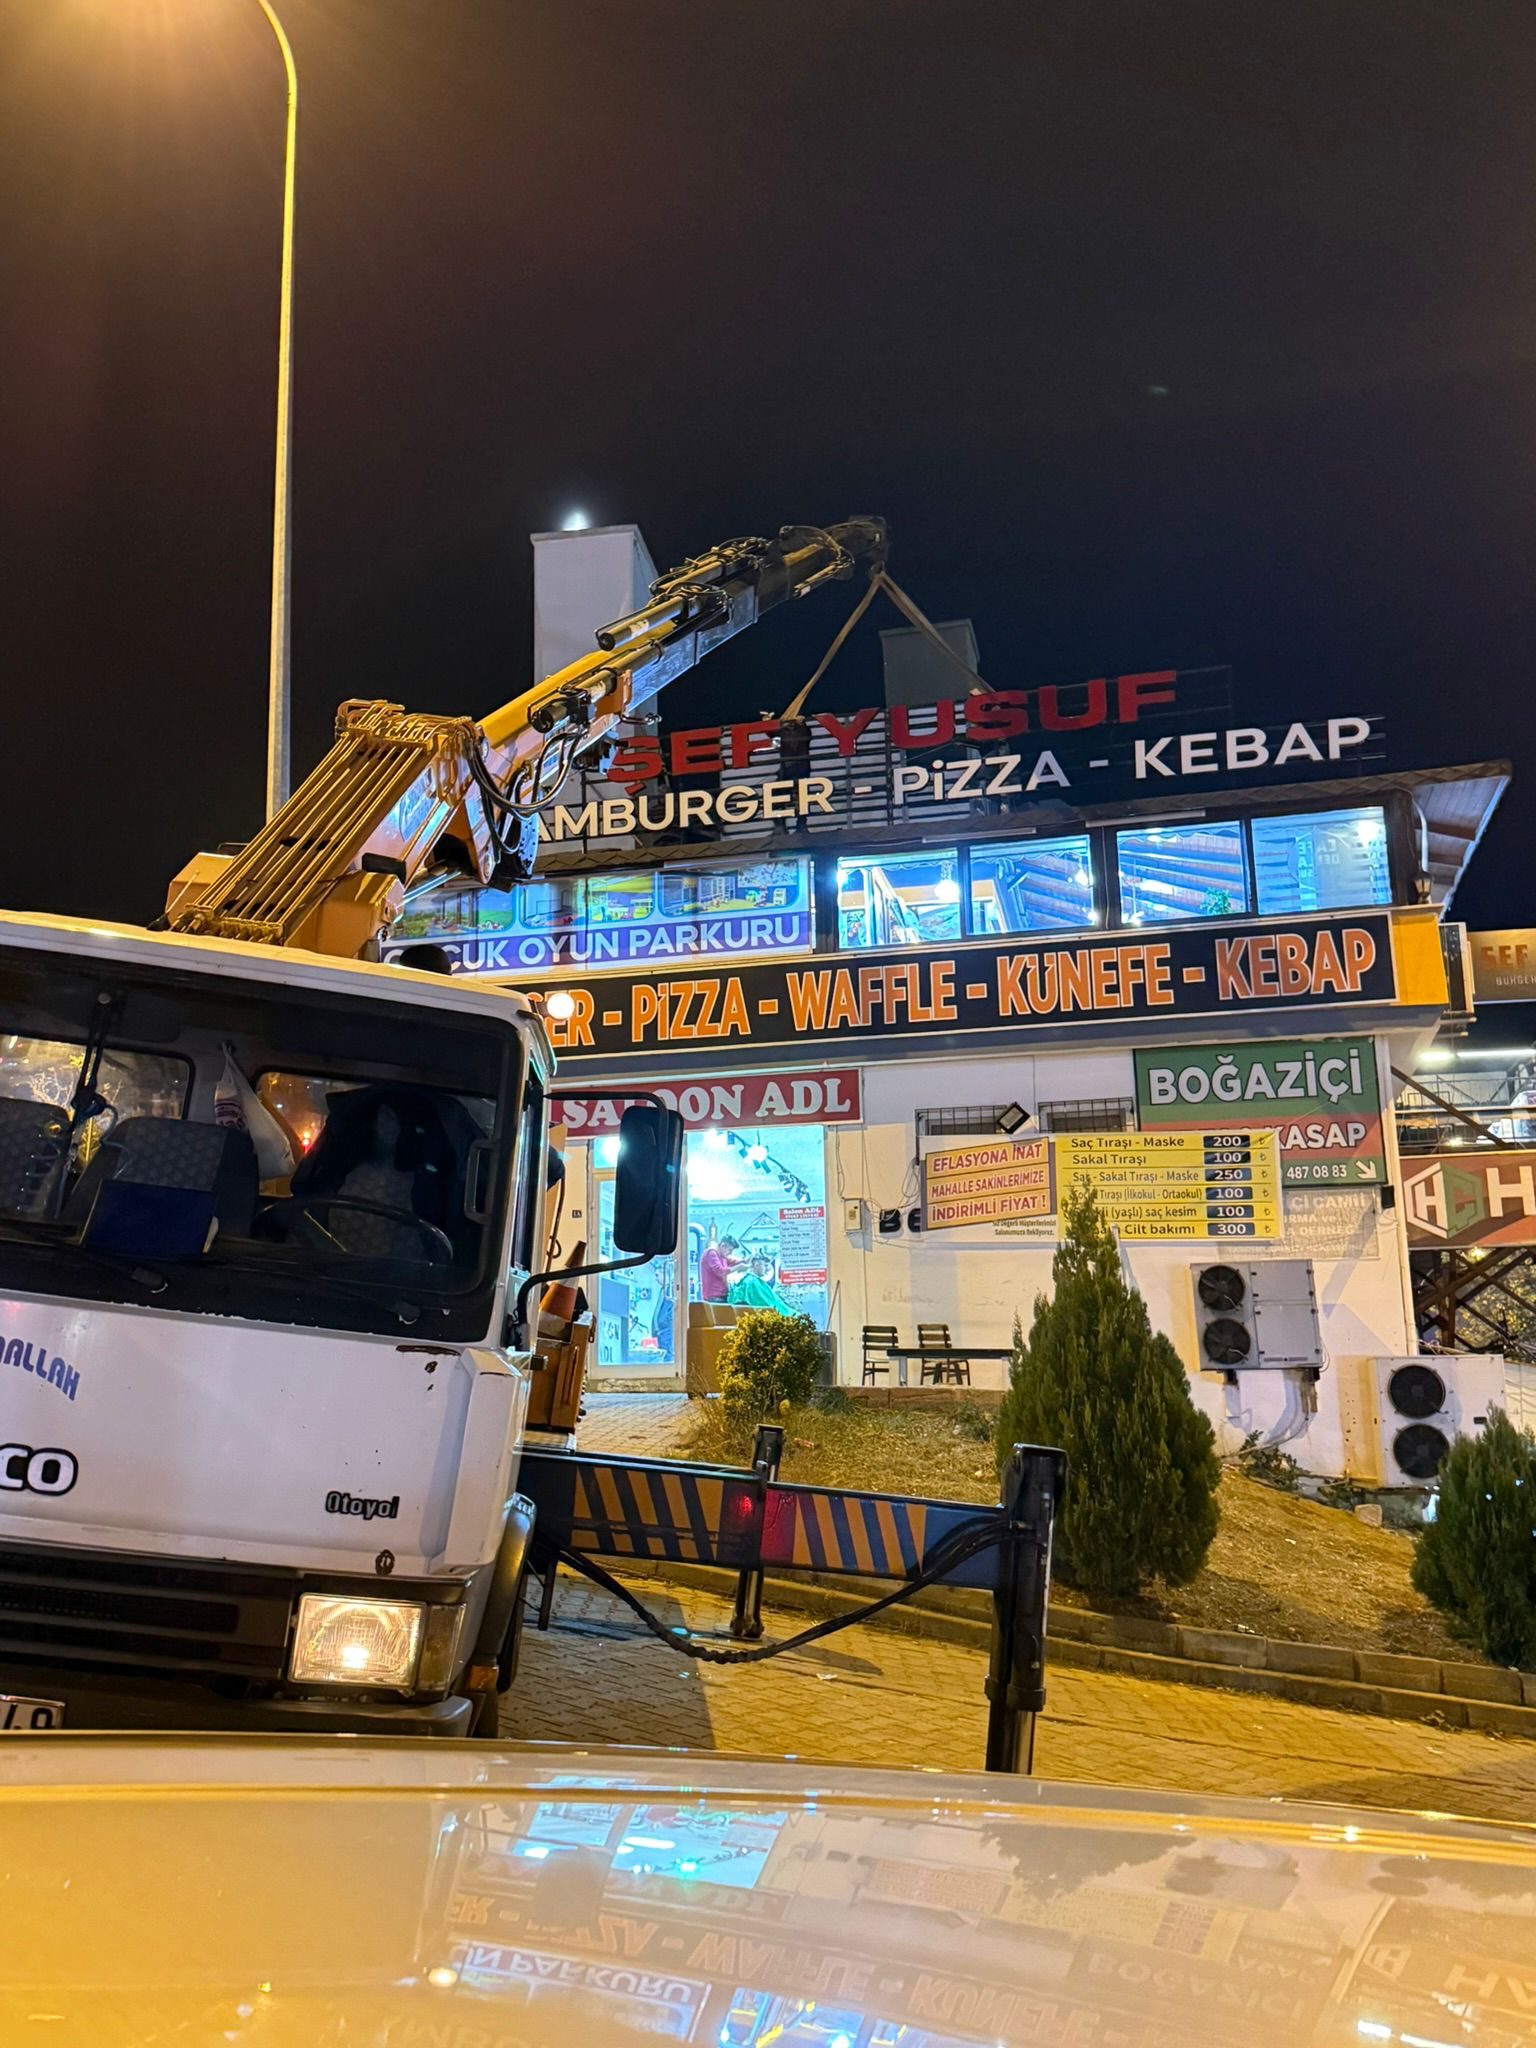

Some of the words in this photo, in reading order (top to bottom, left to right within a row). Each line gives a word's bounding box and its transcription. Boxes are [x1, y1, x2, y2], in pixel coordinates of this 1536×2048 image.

[606, 720, 781, 795] ŞEF
[815, 670, 1177, 756] YUSUF
[538, 776, 834, 842] MBURGER
[1134, 717, 1371, 779] KEBAP
[383, 939, 510, 973] CUK
[518, 928, 619, 965] OYUN
[630, 916, 800, 957] PARKURU
[786, 960, 958, 1030] WAFFLE
[997, 943, 1174, 1016] KÜNEFE
[1215, 928, 1376, 1000] KEBAP
[1148, 1048, 1364, 1106] BOĞAZİÇİ
[562, 1085, 745, 1129] SAON
[755, 1078, 851, 1118] ADL
[1071, 1138, 1094, 1149] Saç
[1096, 1138, 1132, 1149] Tıraşı
[1143, 1137, 1185, 1147] Maske
[1213, 1136, 1242, 1147] 200
[933, 1149, 1009, 1173] EFLASYONA
[1012, 1143, 1043, 1160] İNAT
[1072, 1154, 1108, 1165] Sakal
[1110, 1154, 1147, 1166] Tıraşı
[1214, 1152, 1242, 1163] 100
[1286, 1166, 1309, 1180] 487
[1312, 1165, 1329, 1178] 08
[1332, 1164, 1348, 1178] 83
[931, 1180, 974, 1199] MAHALLE
[975, 1170, 1045, 1192] SAKİNLERİMİZE
[1099, 1171, 1127, 1182] Sakal
[1129, 1171, 1158, 1183] Tıraşı
[1166, 1170, 1199, 1181] Maske
[1213, 1169, 1243, 1180] 250
[932, 1198, 997, 1222] İNDİRİMLİ
[1000, 1195, 1038, 1213] FİYAT
[1100, 1189, 1121, 1201] Tıraşı
[1161, 1188, 1202, 1200] Ortaokul)
[1216, 1188, 1244, 1199] 100
[1111, 1206, 1143, 1219] (yaşlı)
[1145, 1208, 1162, 1219] saç
[1165, 1205, 1197, 1217] kesim
[1217, 1206, 1245, 1217] 100
[1124, 1224, 1148, 1235] Cilt
[1150, 1223, 1196, 1235] bakımı
[1217, 1224, 1246, 1235] 300
[0, 1443, 79, 1497] CO
[325, 1491, 400, 1520] Otoyol
